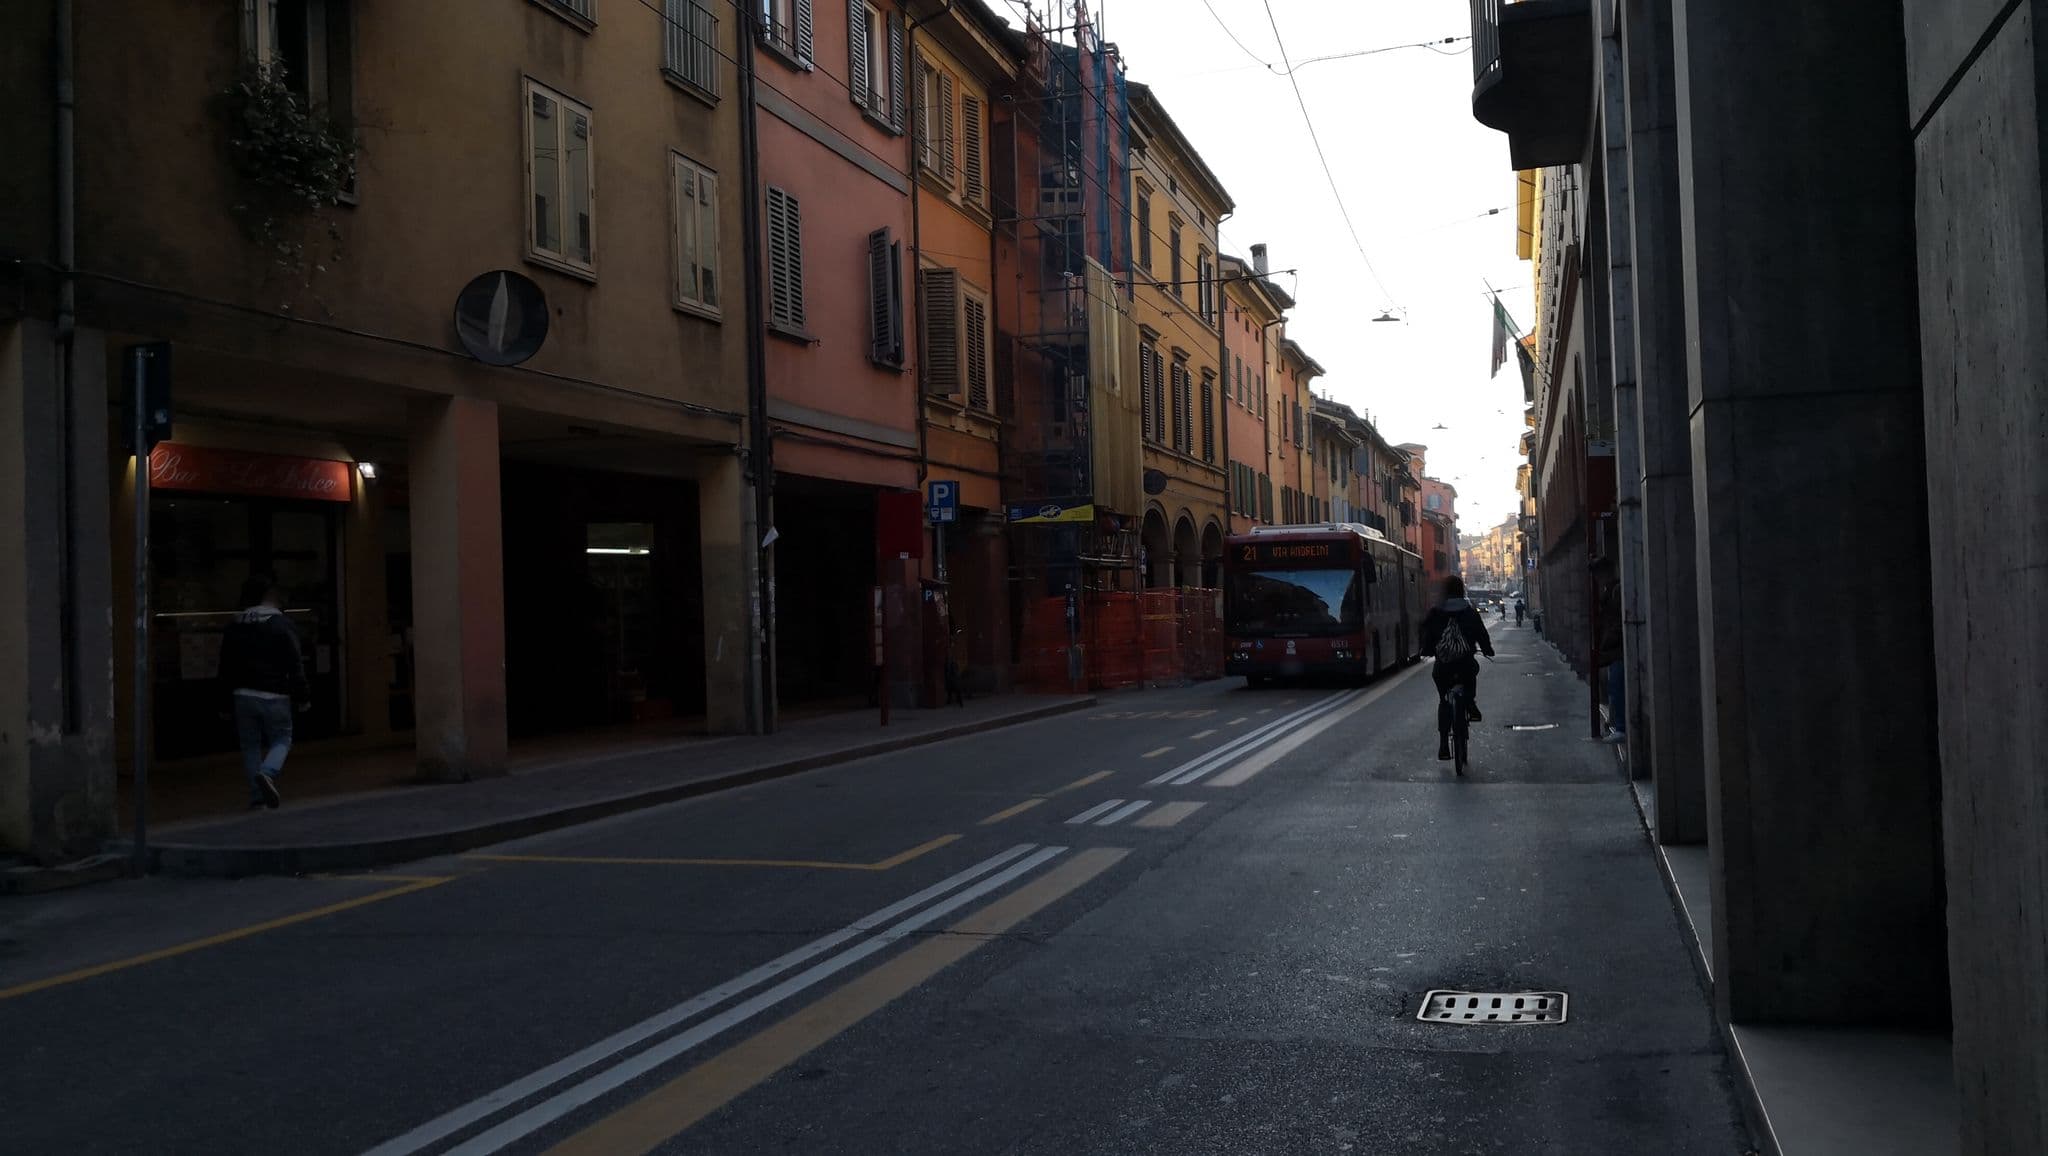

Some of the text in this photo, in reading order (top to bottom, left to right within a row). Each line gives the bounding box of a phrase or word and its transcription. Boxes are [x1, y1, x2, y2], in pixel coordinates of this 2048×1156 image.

[150, 448, 200, 482] Bar
[933, 484, 949, 506] P
[1243, 545, 1257, 561] 21
